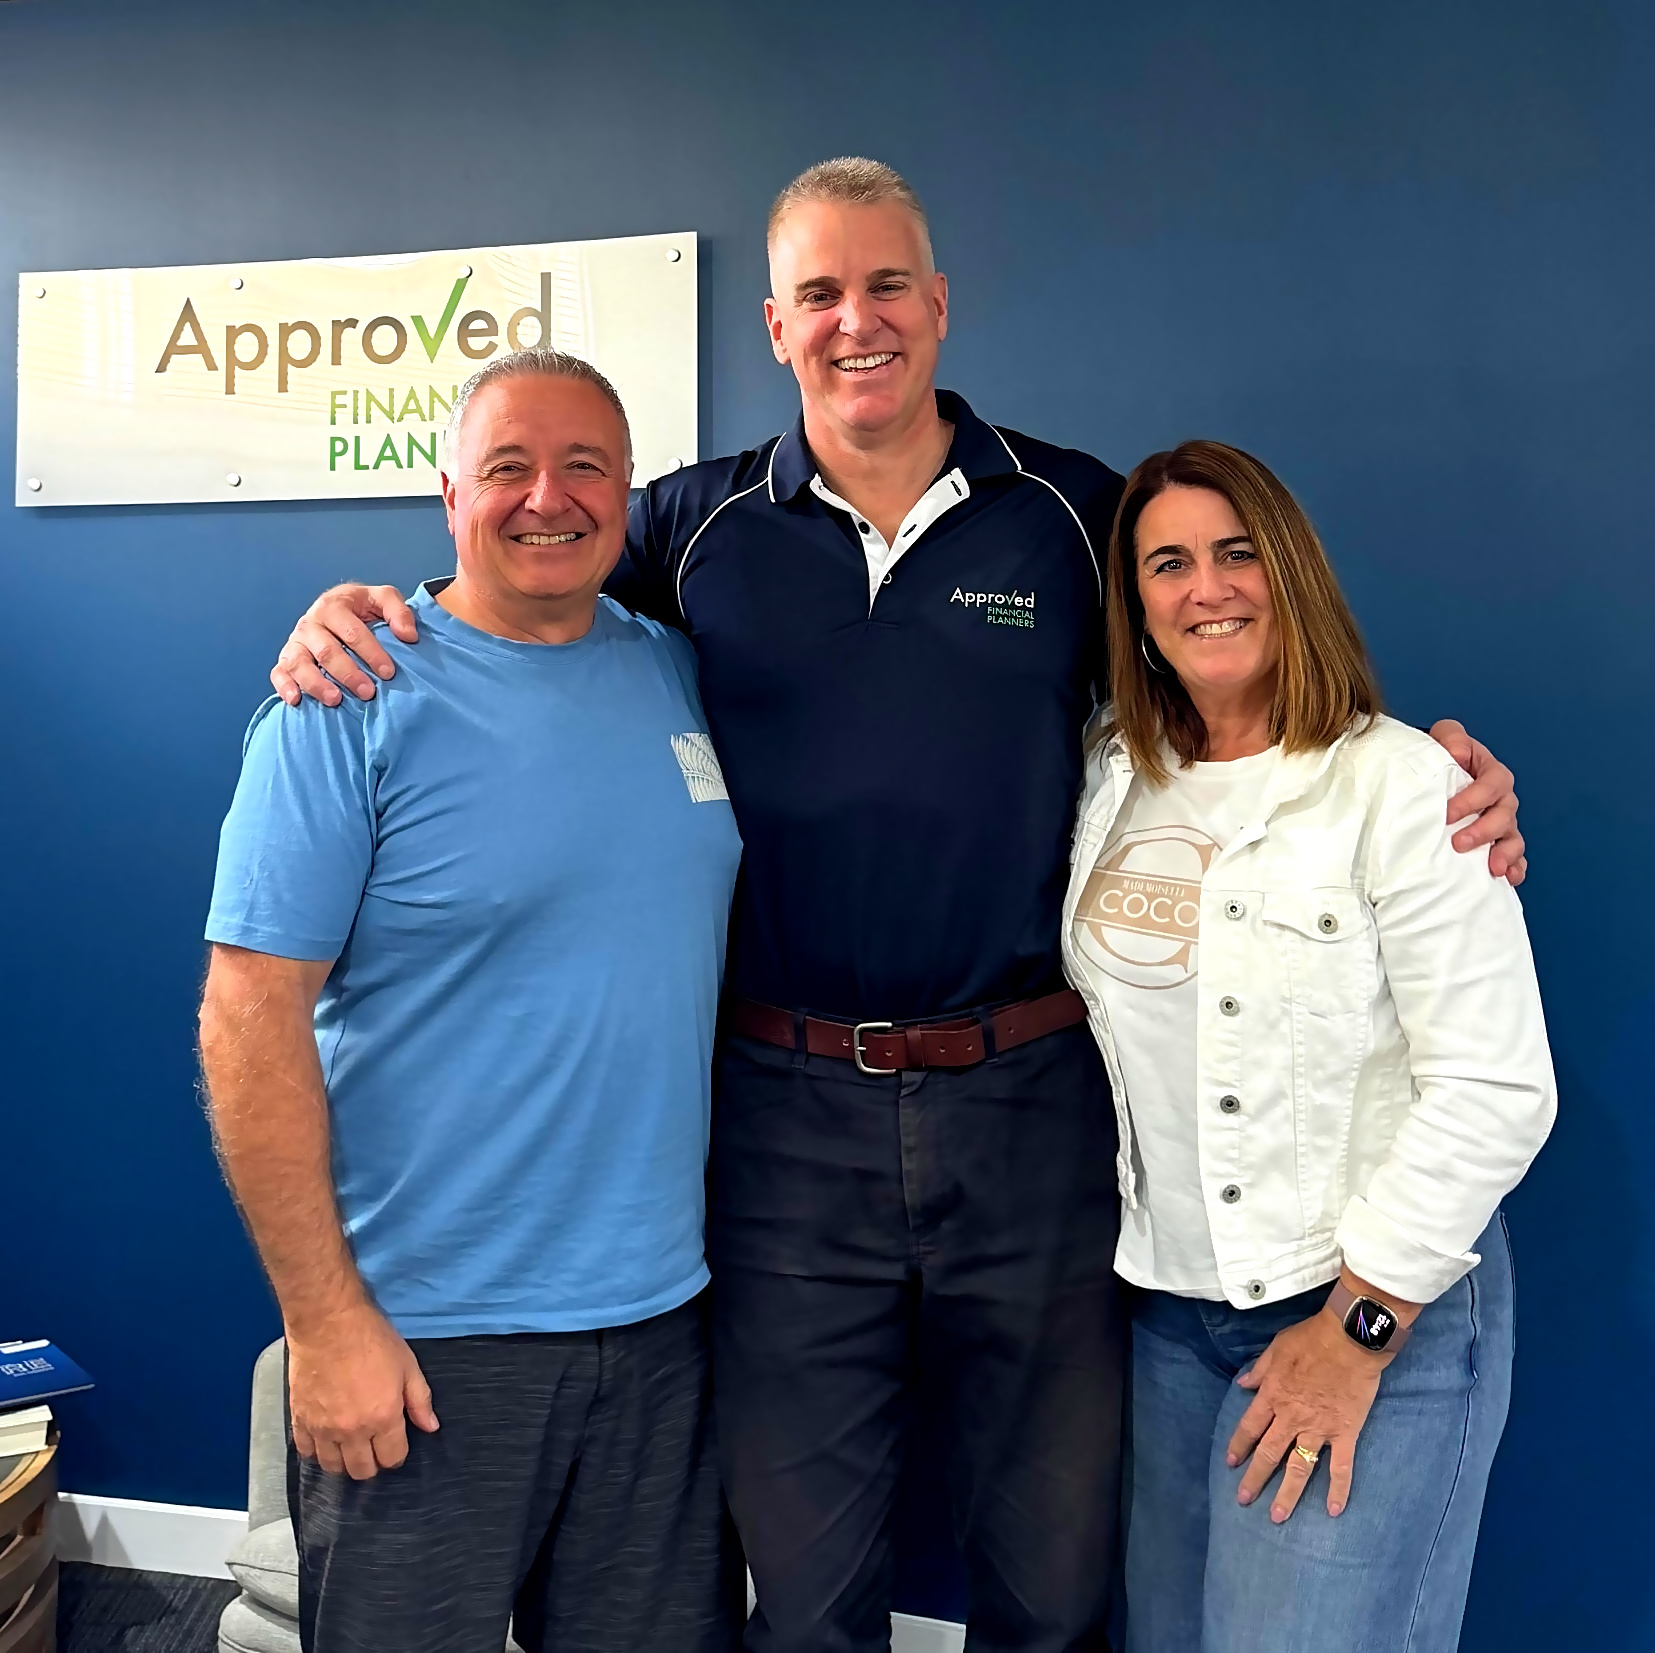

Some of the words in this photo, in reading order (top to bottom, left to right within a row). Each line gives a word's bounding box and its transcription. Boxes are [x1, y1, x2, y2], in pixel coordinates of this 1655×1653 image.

[155, 272, 551, 395] Approved
[330, 384, 459, 425] FINAN
[329, 431, 446, 471] PLAN
[949, 587, 1035, 609] Approved
[987, 606, 1035, 620] FINANCIAL
[987, 615, 1035, 629] PLANNERS
[1099, 889, 1200, 928] COCO
